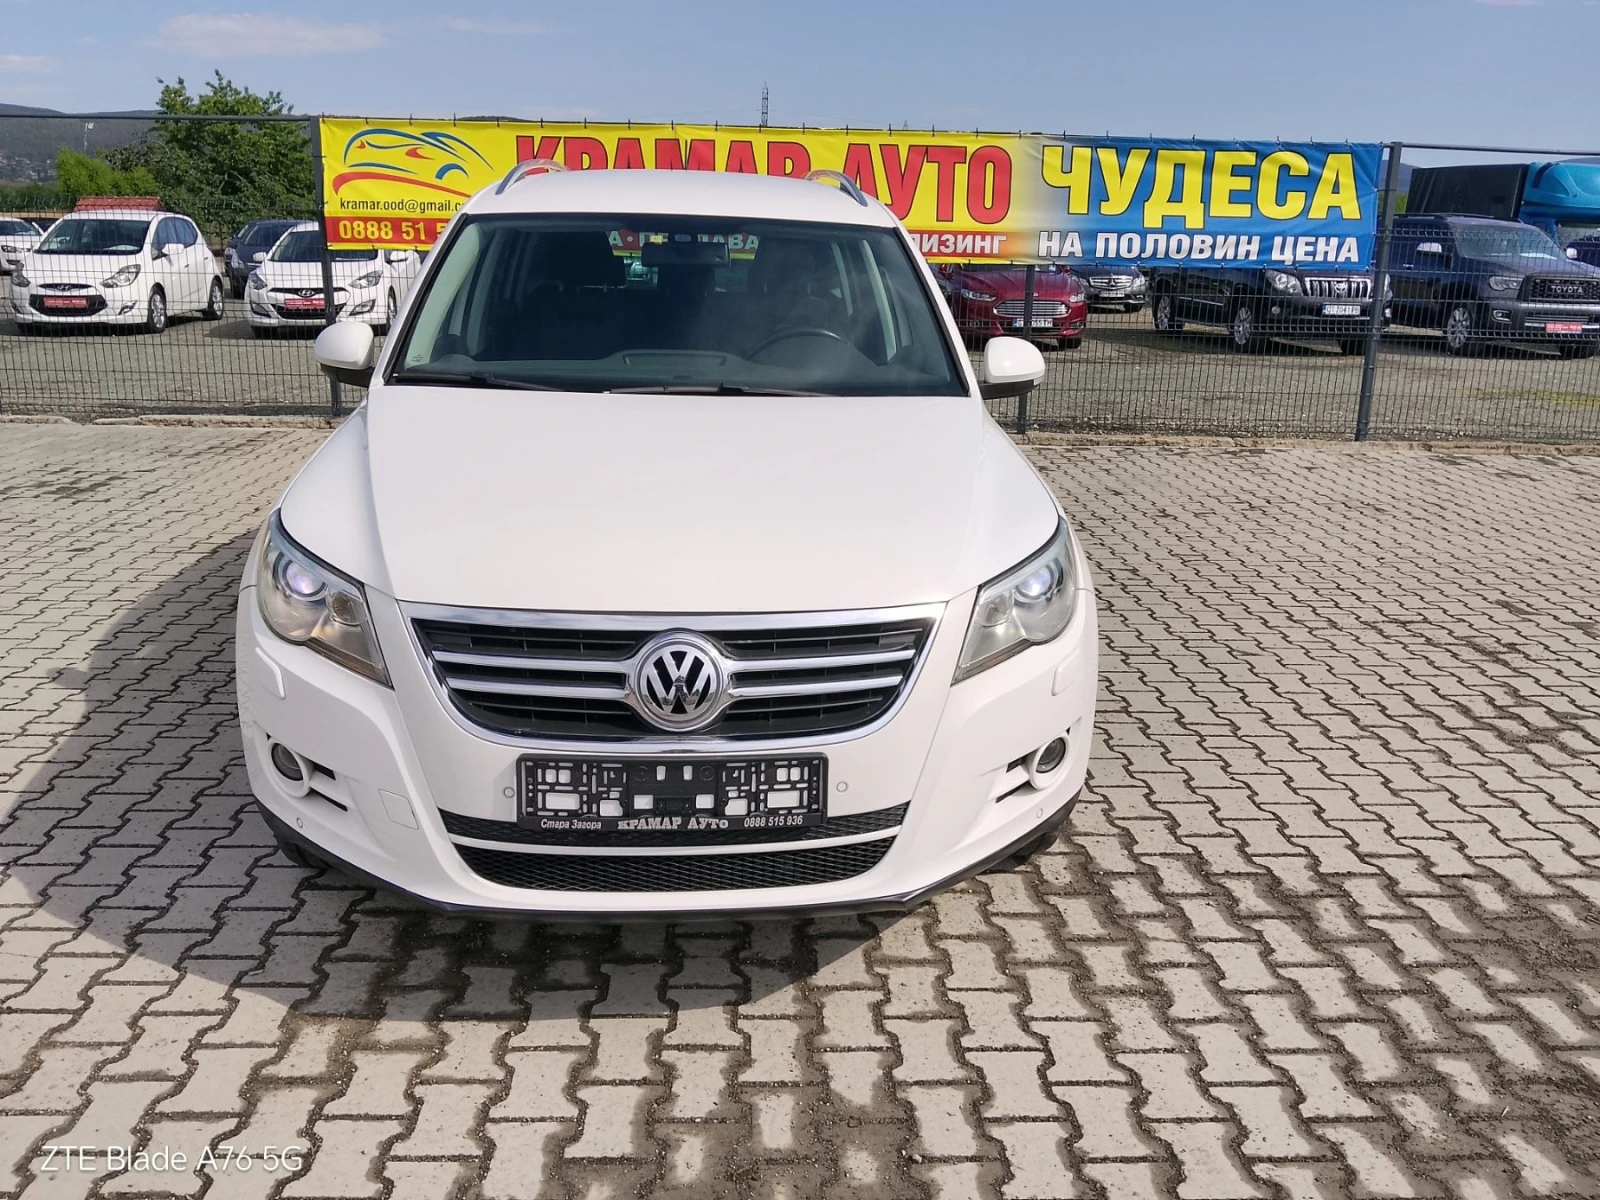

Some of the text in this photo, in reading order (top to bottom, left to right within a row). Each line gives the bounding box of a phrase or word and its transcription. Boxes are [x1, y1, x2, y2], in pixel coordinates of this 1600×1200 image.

[842, 143, 1012, 224] АУТО
[1041, 145, 1362, 230] ЧУДЕСА
[340, 197, 464, 213] kramar.ood@gmail.c
[338, 220, 393, 239] 0888
[401, 221, 426, 240] 51
[1038, 231, 1359, 265] НА ПОЛОВИН ЦЕНА
[1551, 285, 1583, 293] TOYOTA
[540, 815, 803, 830] Стара Загора КРАМАР АУТО 0888 515 936
